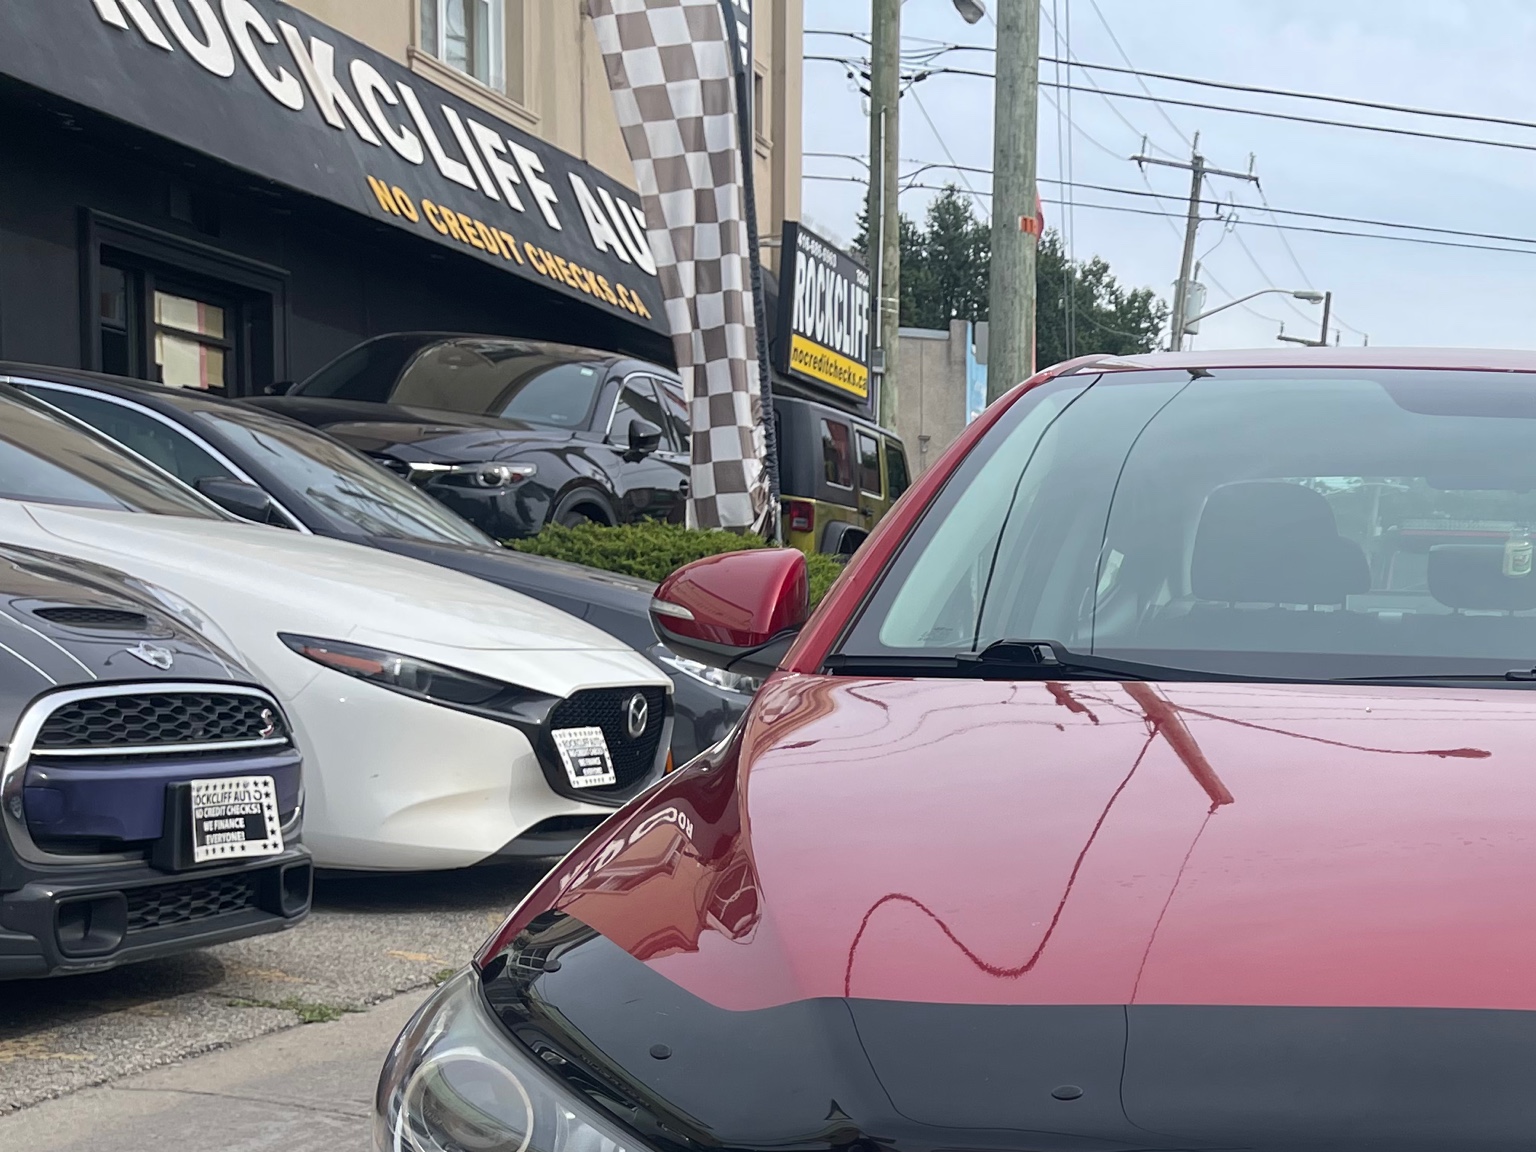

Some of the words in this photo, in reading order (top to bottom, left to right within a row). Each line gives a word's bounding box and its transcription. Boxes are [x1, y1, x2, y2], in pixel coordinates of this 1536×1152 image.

[568, 172, 657, 276] AU
[366, 175, 420, 223] NO
[421, 199, 525, 266] CREDIT
[524, 242, 652, 319] CHECKS.CA
[792, 250, 869, 362] ROCKCLIFF
[792, 347, 869, 391] nocreditchecks.ca
[194, 791, 232, 806] OCKCLIFF
[204, 805, 226, 818] CREDIT
[226, 803, 261, 816] CHECKS!
[214, 817, 245, 831] FINANCE
